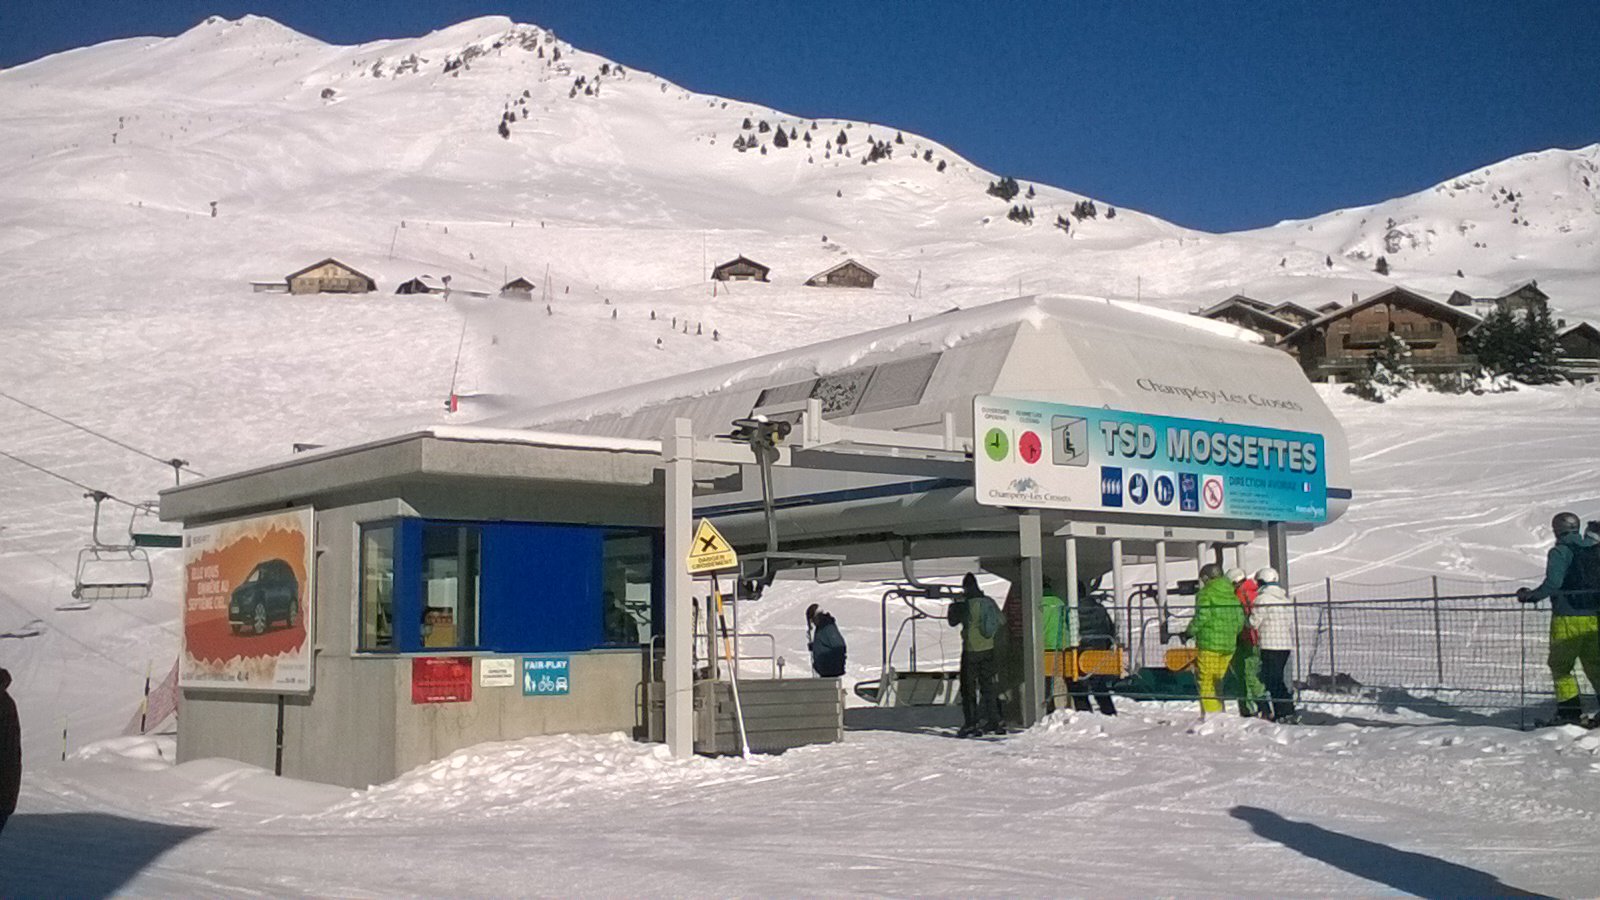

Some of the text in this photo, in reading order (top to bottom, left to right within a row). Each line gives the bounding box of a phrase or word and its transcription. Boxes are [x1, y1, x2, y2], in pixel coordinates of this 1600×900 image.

[1248, 394, 1303, 412] Crosets
[1098, 420, 1318, 474] TSD MOSSETTES
[524, 660, 568, 671] FAIR-PLAY
